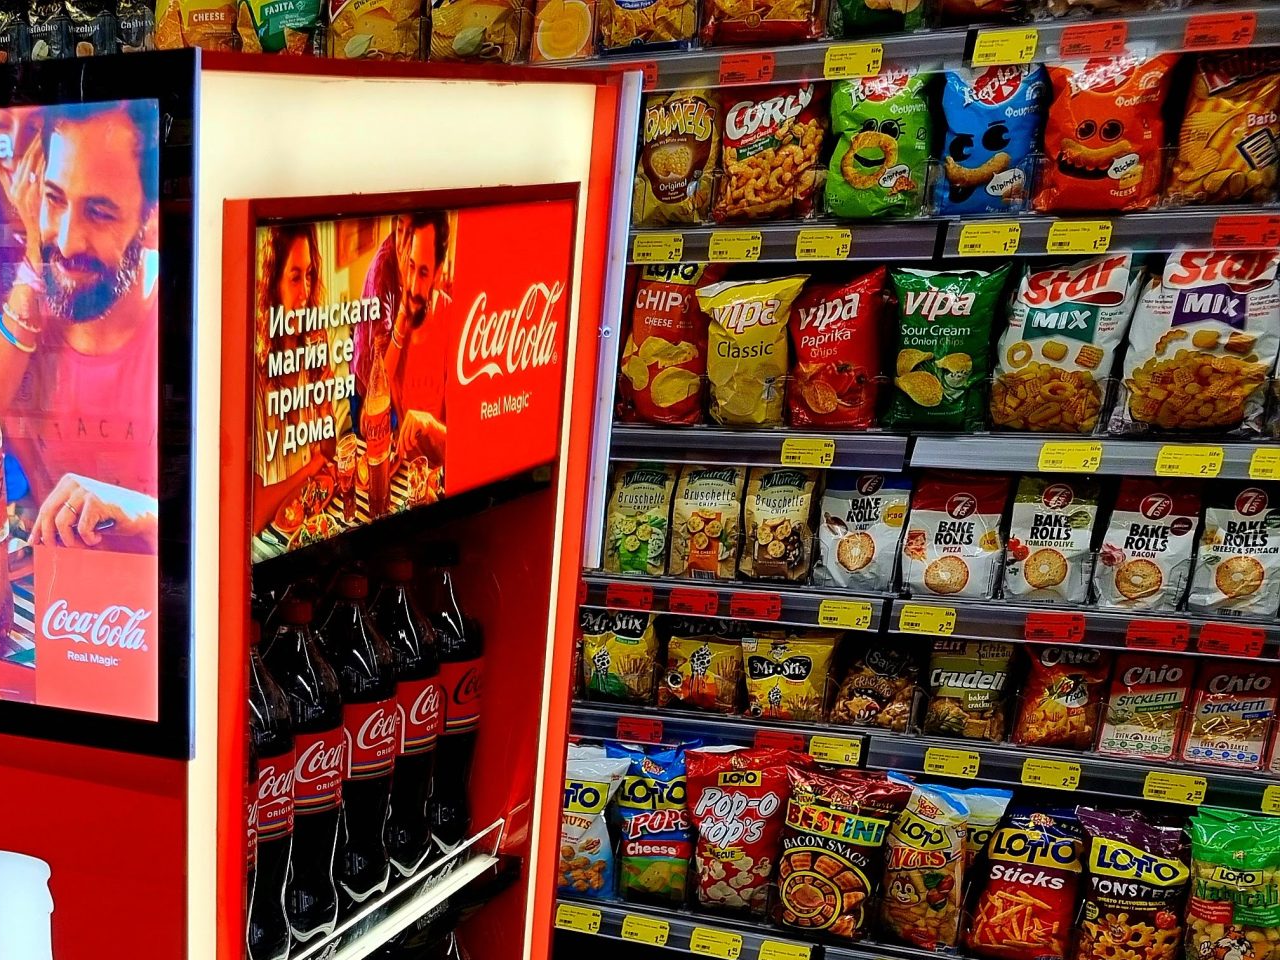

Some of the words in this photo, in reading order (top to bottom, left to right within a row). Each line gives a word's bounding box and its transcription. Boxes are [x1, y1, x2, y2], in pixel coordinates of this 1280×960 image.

[264, 2, 295, 16] FAJITA
[193, 12, 225, 23] CHEESE
[1169, 250, 1277, 284] Star
[1023, 255, 1128, 305] Star
[635, 288, 690, 315] CHIPS
[1183, 291, 1240, 318] MIX
[269, 295, 381, 339] Истинската
[644, 316, 673, 328] CHEESE
[1031, 308, 1092, 330] MIX
[456, 280, 566, 386] Coca-Cola
[901, 323, 926, 337] Sour
[928, 325, 970, 337] Cream
[800, 328, 852, 349] Paprika
[911, 336, 937, 347] Onion
[717, 340, 774, 359] Classic
[268, 342, 327, 378] магия
[333, 338, 354, 364] се
[267, 372, 356, 416] приготвя
[480, 399, 501, 420] Real
[503, 392, 530, 416] Magic
[266, 429, 278, 462] у
[283, 413, 335, 455] дома
[618, 490, 665, 505] Bruschette
[683, 488, 736, 502] Bruschette
[755, 494, 804, 508] Bruschette
[851, 498, 881, 512] BAKE
[846, 509, 881, 524] ROLLS
[1033, 513, 1072, 528] BAKE
[937, 521, 974, 535] BAKE
[1030, 526, 1072, 541] ROLLS
[1131, 523, 1170, 539] BAKE
[1227, 520, 1268, 534] BAKE
[934, 532, 974, 546] ROLLS
[1025, 539, 1050, 548] TOMATO
[1052, 539, 1074, 548] OLIVE
[1124, 536, 1169, 552] ROLLS
[1223, 531, 1268, 547] ROLLS
[1131, 550, 1157, 559] BACON
[42, 599, 152, 651] Coca-Cola
[67, 650, 89, 663] Real
[90, 652, 119, 666] Magic
[930, 668, 1007, 691] Crudeli
[1124, 664, 1183, 687] Chio
[1209, 673, 1272, 695] Chio
[968, 693, 990, 702] baked
[1116, 690, 1178, 707] STICKLETTI
[1201, 700, 1266, 714] STICKLETTI
[629, 809, 692, 838] POPS
[785, 799, 890, 846] BESTINI
[626, 842, 677, 856] Cheese
[783, 834, 824, 850] BACON
[888, 848, 948, 870] NUTS
[1096, 843, 1177, 881] LOTTO
[990, 864, 1065, 890] Sticks
